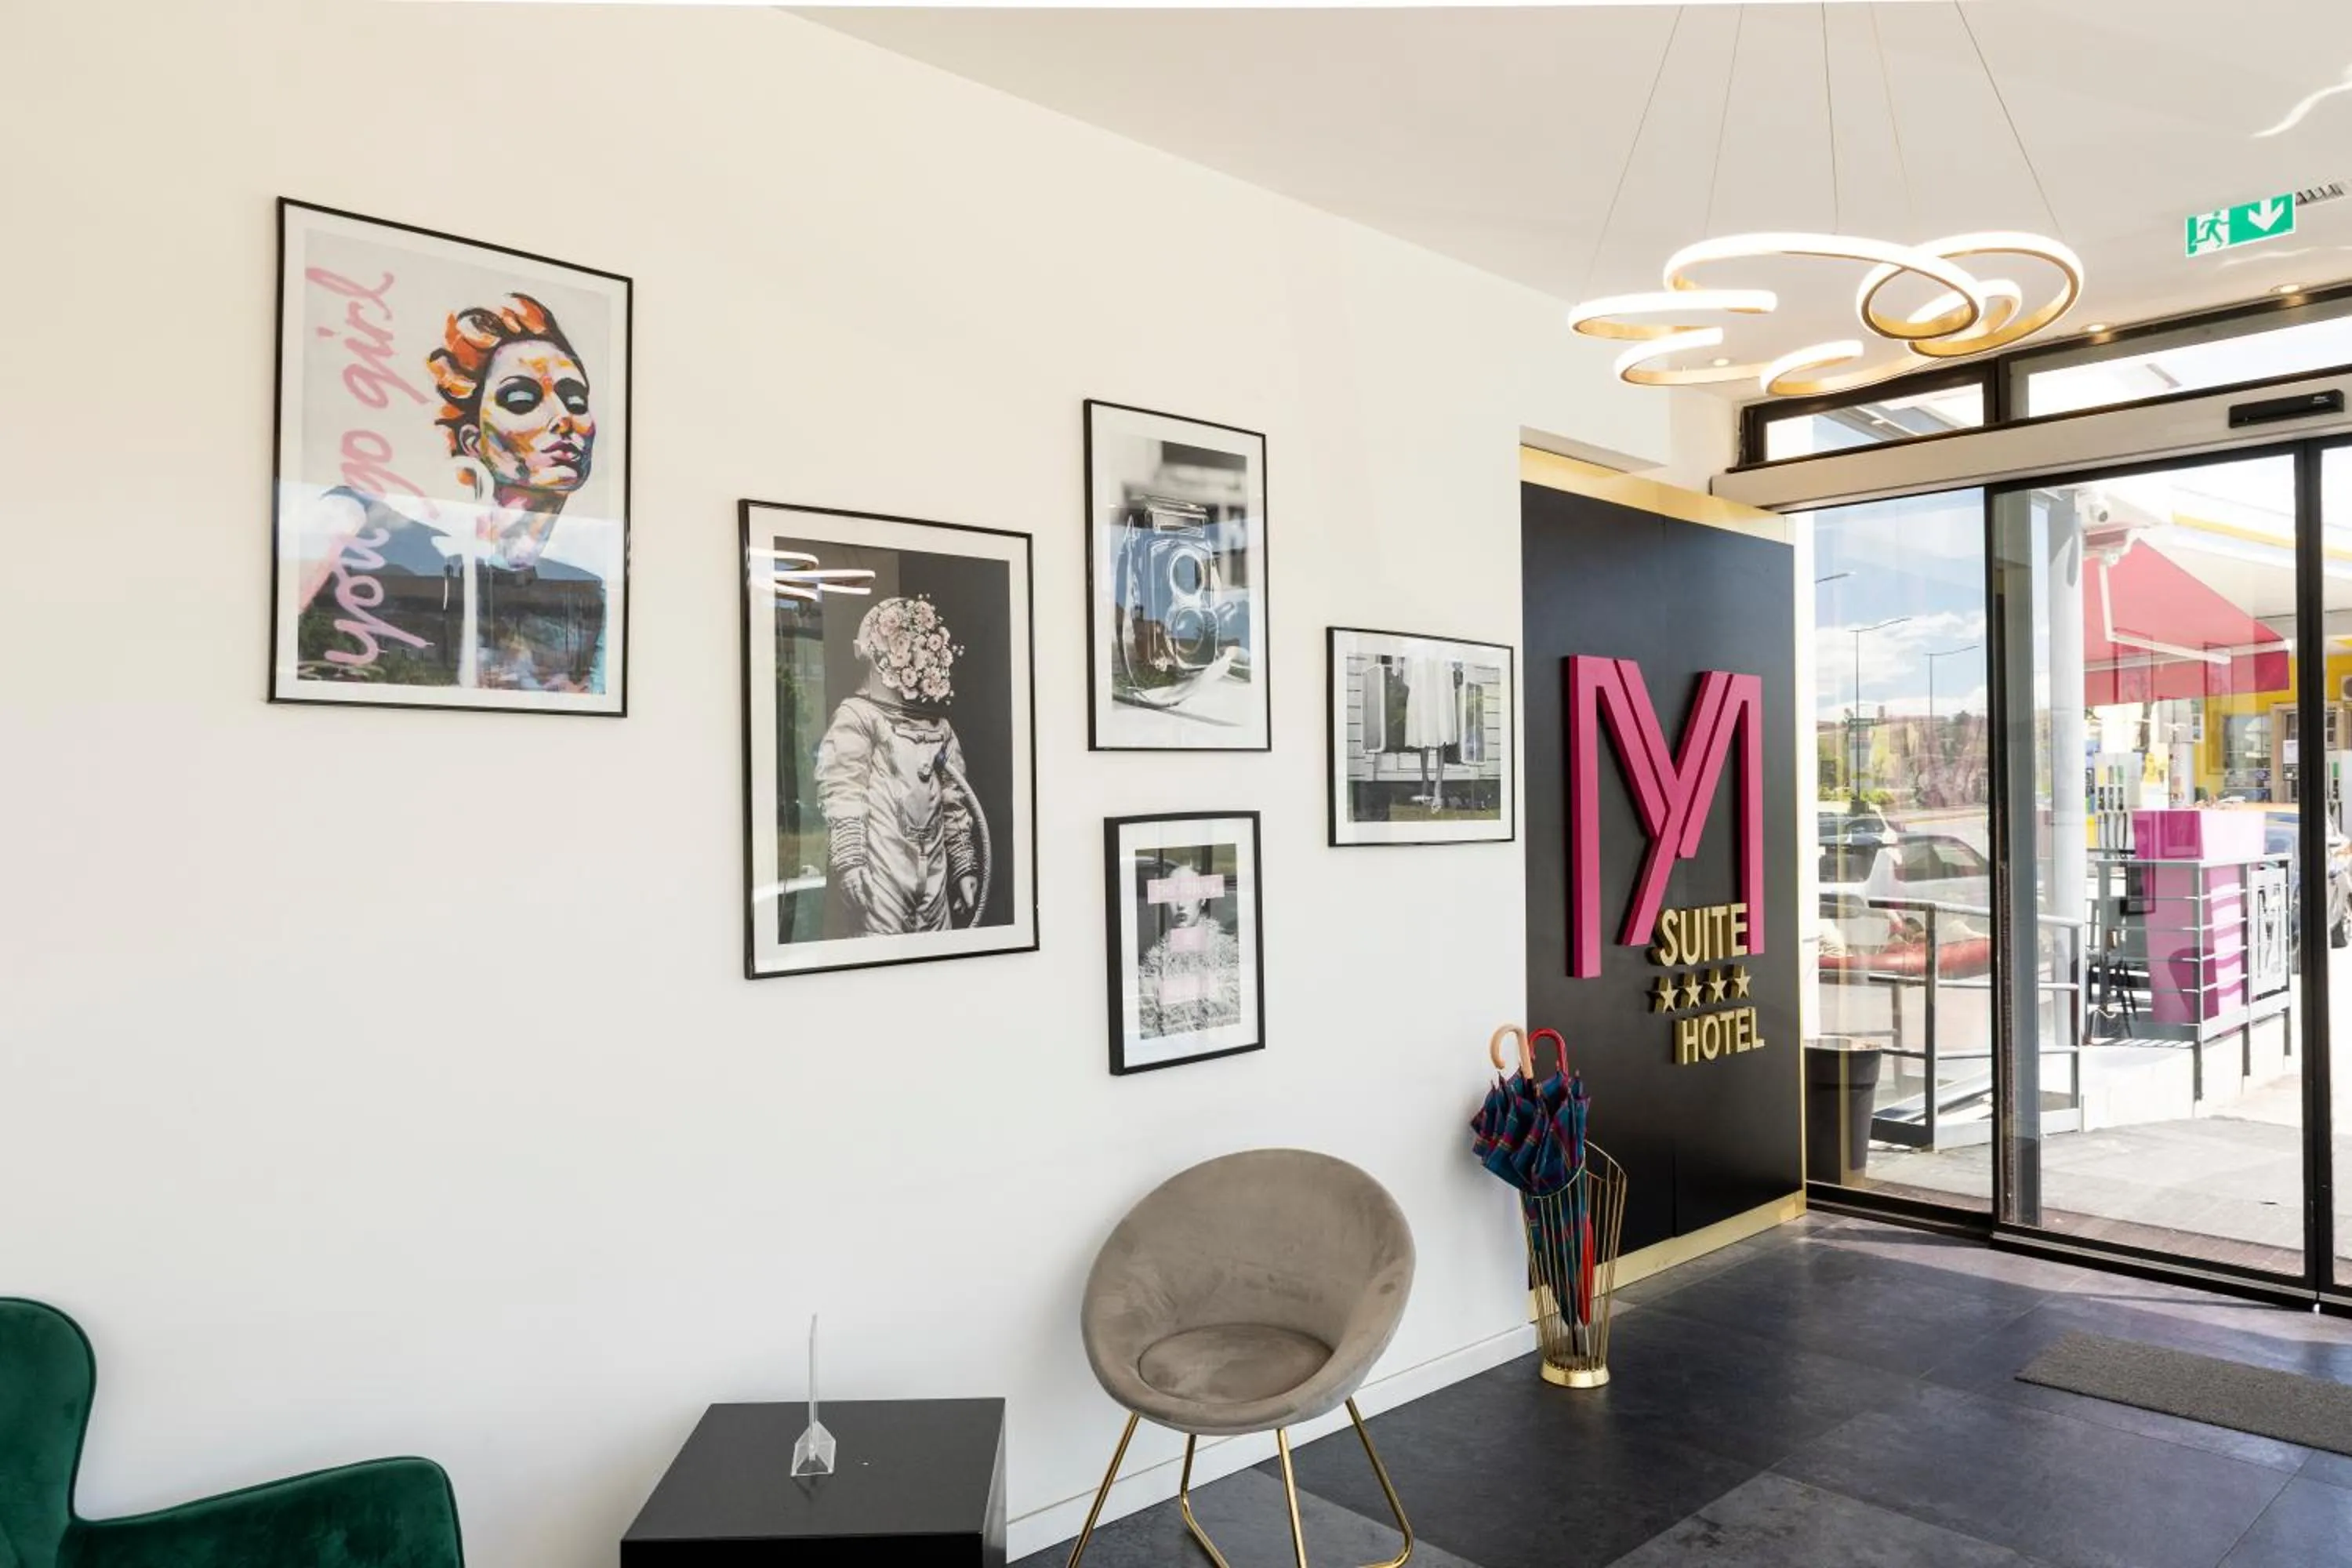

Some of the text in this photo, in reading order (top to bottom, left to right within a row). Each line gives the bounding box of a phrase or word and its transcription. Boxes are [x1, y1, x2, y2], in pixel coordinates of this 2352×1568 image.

[303, 267, 441, 666] you go girl
[1653, 902, 1748, 967] SUITE
[1675, 1007, 1766, 1065] HOTEL
